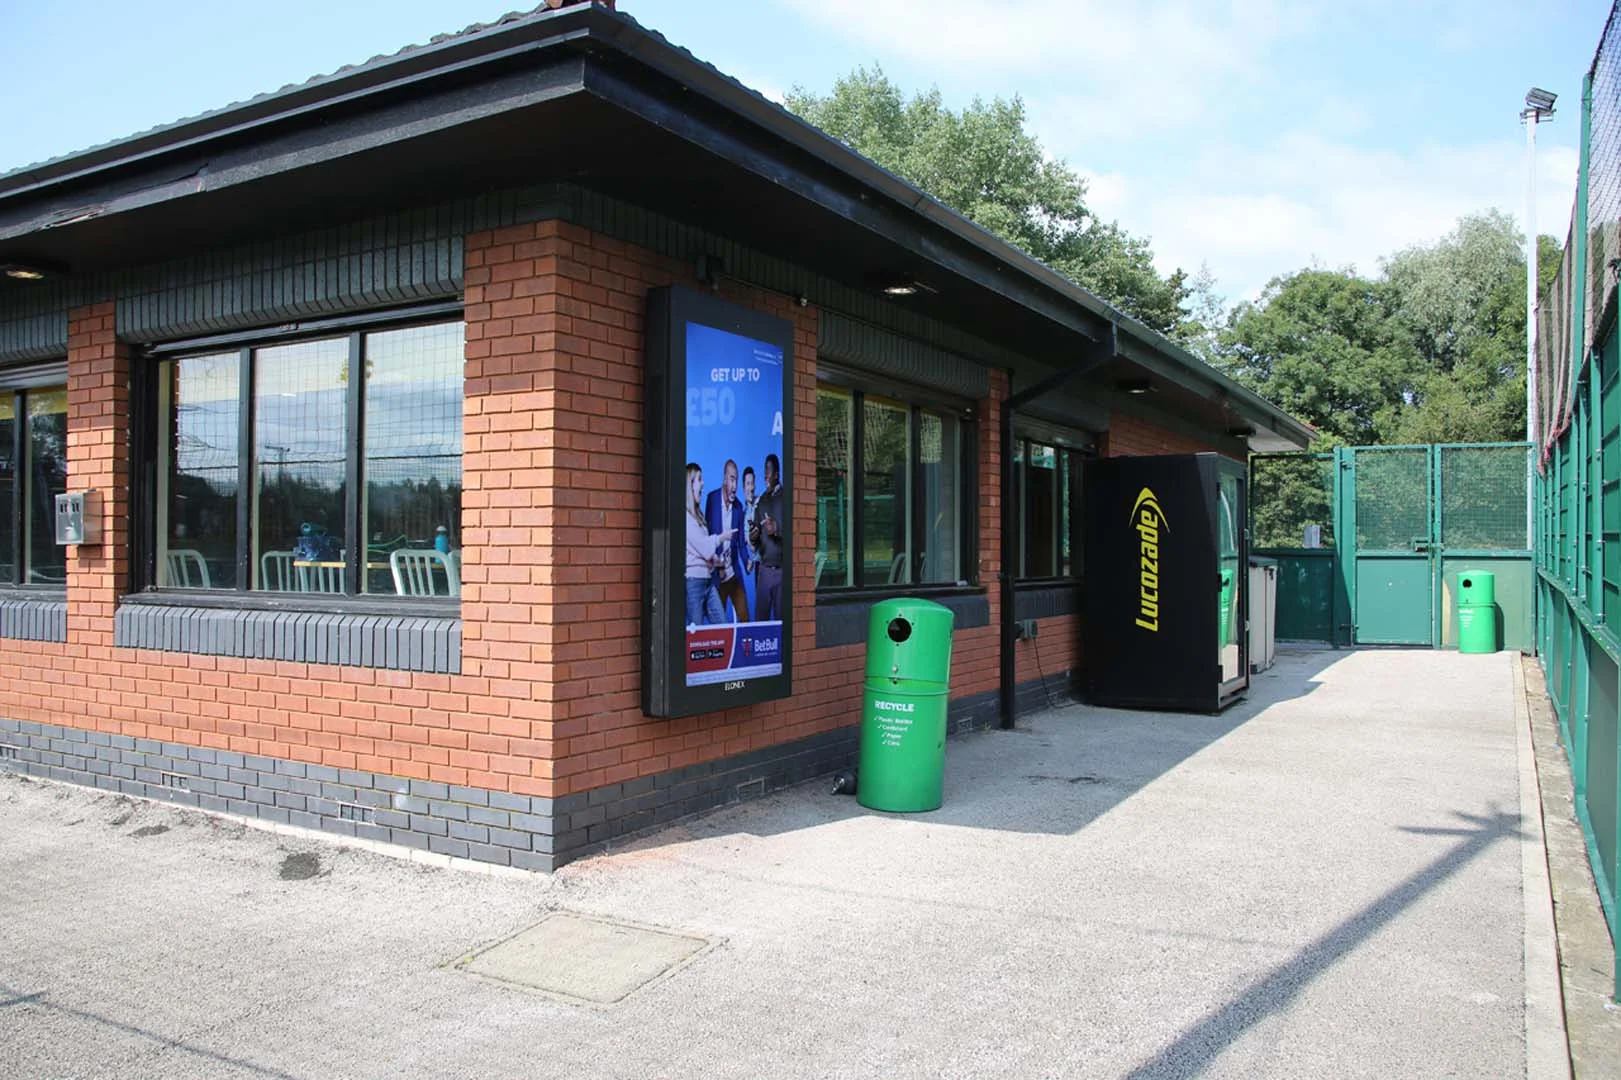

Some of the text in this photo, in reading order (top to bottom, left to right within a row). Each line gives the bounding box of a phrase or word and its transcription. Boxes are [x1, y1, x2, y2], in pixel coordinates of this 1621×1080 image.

[711, 367, 760, 382] GET UP TO
[1135, 509, 1159, 632] Lucozade
[754, 638, 779, 652] BetBull
[874, 700, 914, 713] RECYCLE
